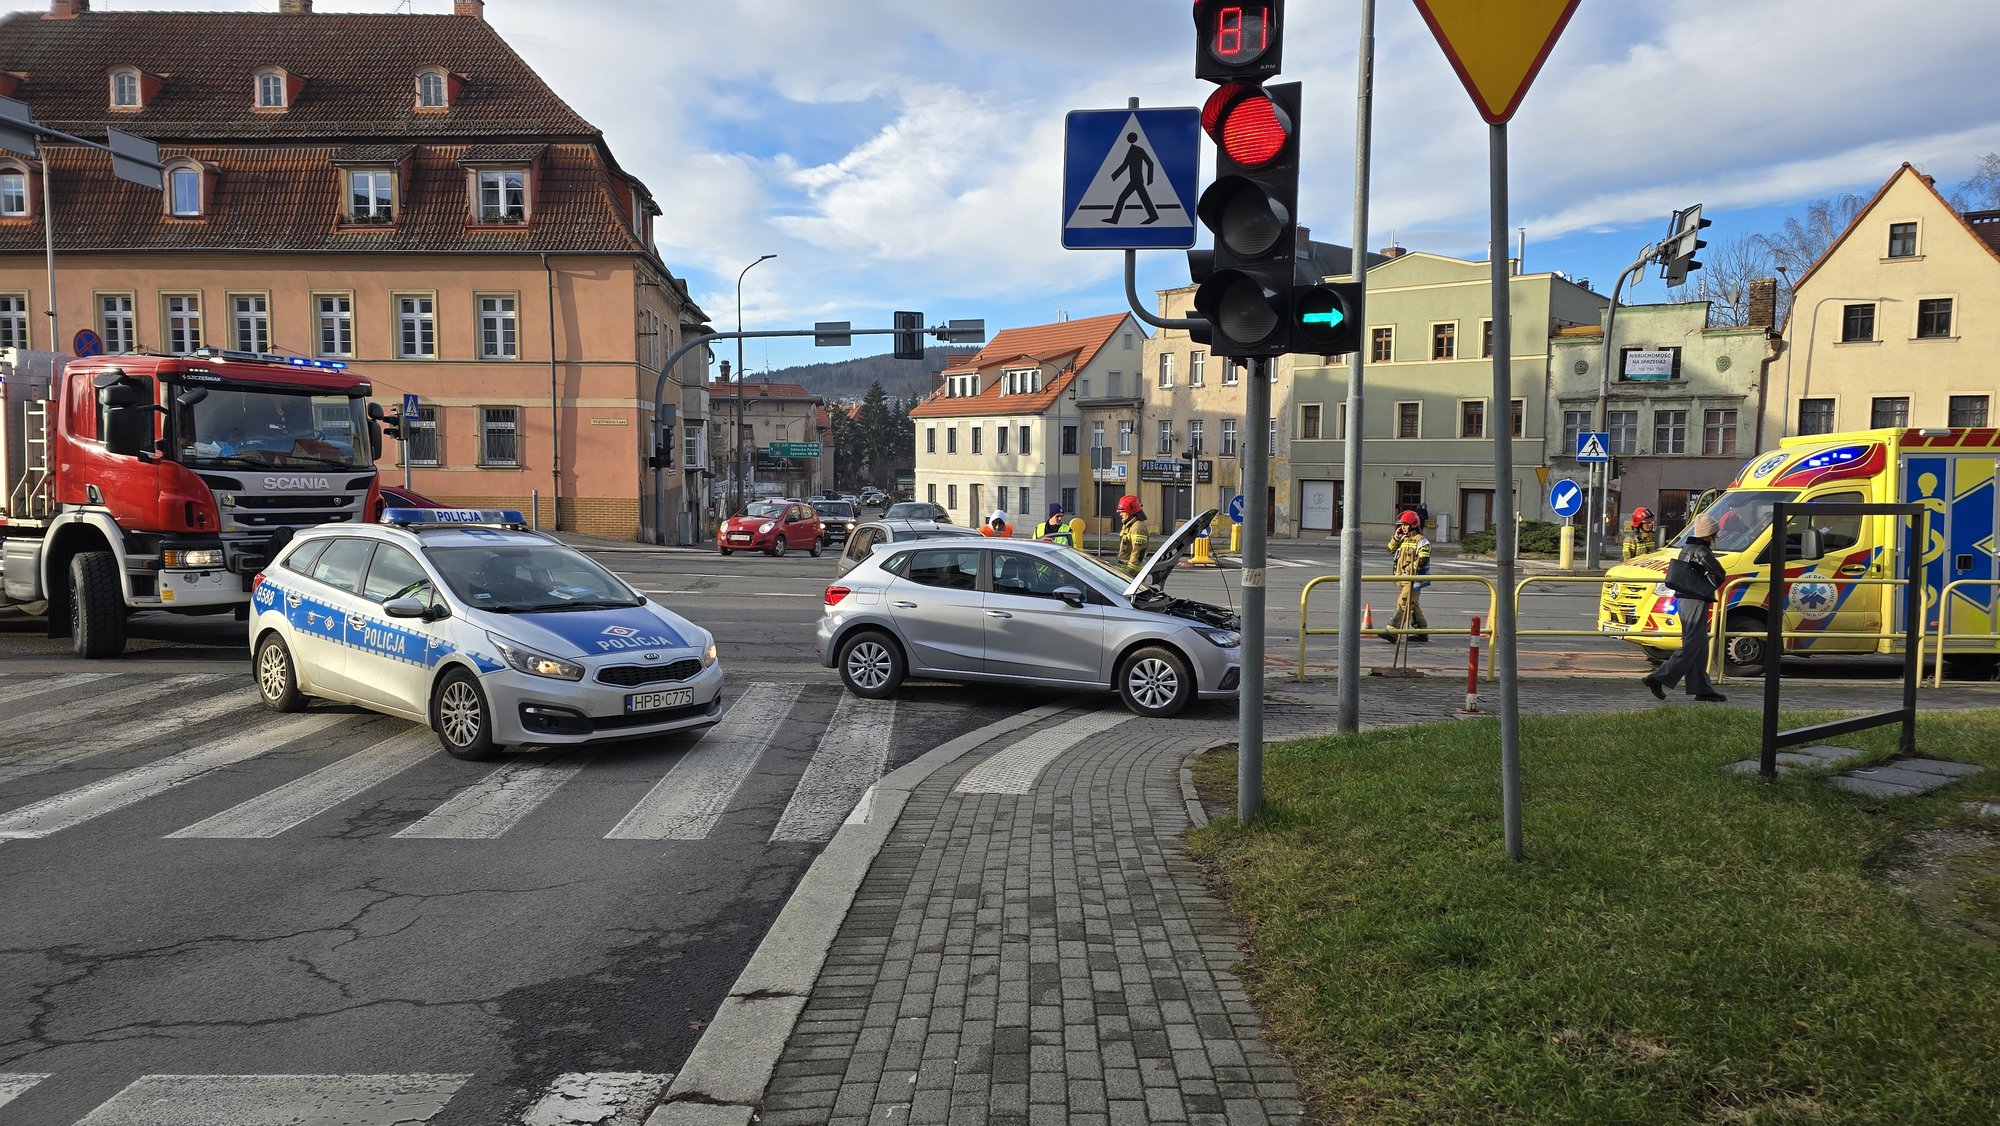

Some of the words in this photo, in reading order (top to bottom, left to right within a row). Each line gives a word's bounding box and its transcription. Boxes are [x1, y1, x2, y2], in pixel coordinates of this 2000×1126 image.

[1218, 6, 1269, 56] 81
[263, 477, 330, 490] SCANIA
[437, 510, 482, 523] POLICJA
[257, 586, 276, 607] B588
[364, 627, 406, 654] POLICJA
[596, 636, 674, 651] POLICJA
[634, 695, 661, 710] HPB
[665, 690, 692, 706] C775
